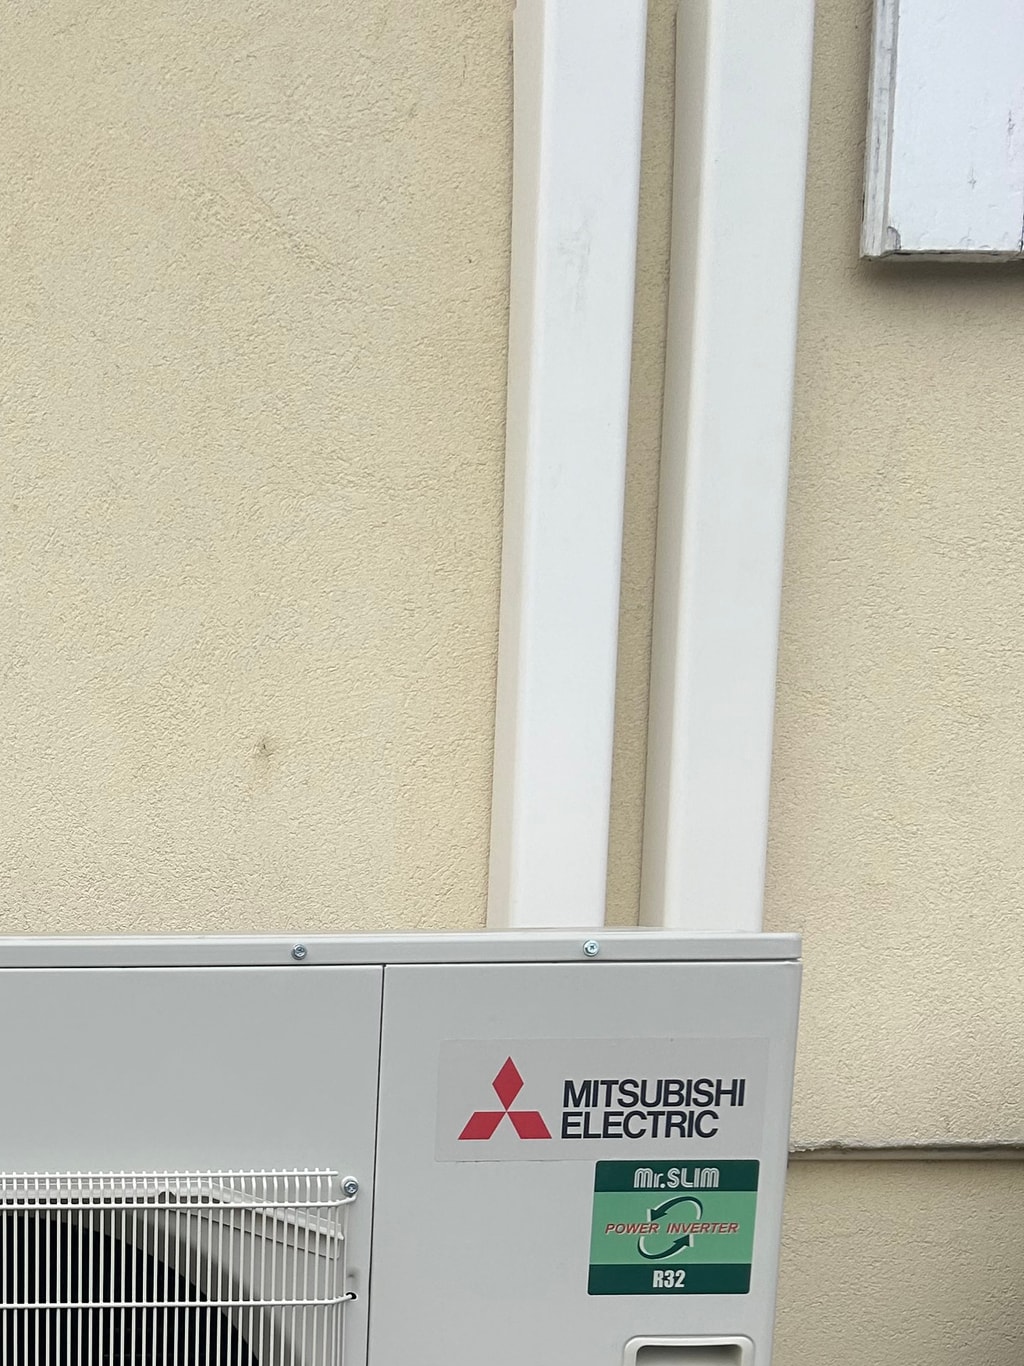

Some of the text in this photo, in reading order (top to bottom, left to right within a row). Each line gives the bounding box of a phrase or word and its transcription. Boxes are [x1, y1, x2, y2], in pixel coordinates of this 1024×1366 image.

[563, 1078, 746, 1108] MITSUBISHI
[560, 1110, 720, 1140] ELECTRIC
[633, 1167, 720, 1189] Mr.SLIM
[605, 1222, 739, 1235] POWER INVERTER
[652, 1270, 686, 1288] R32
